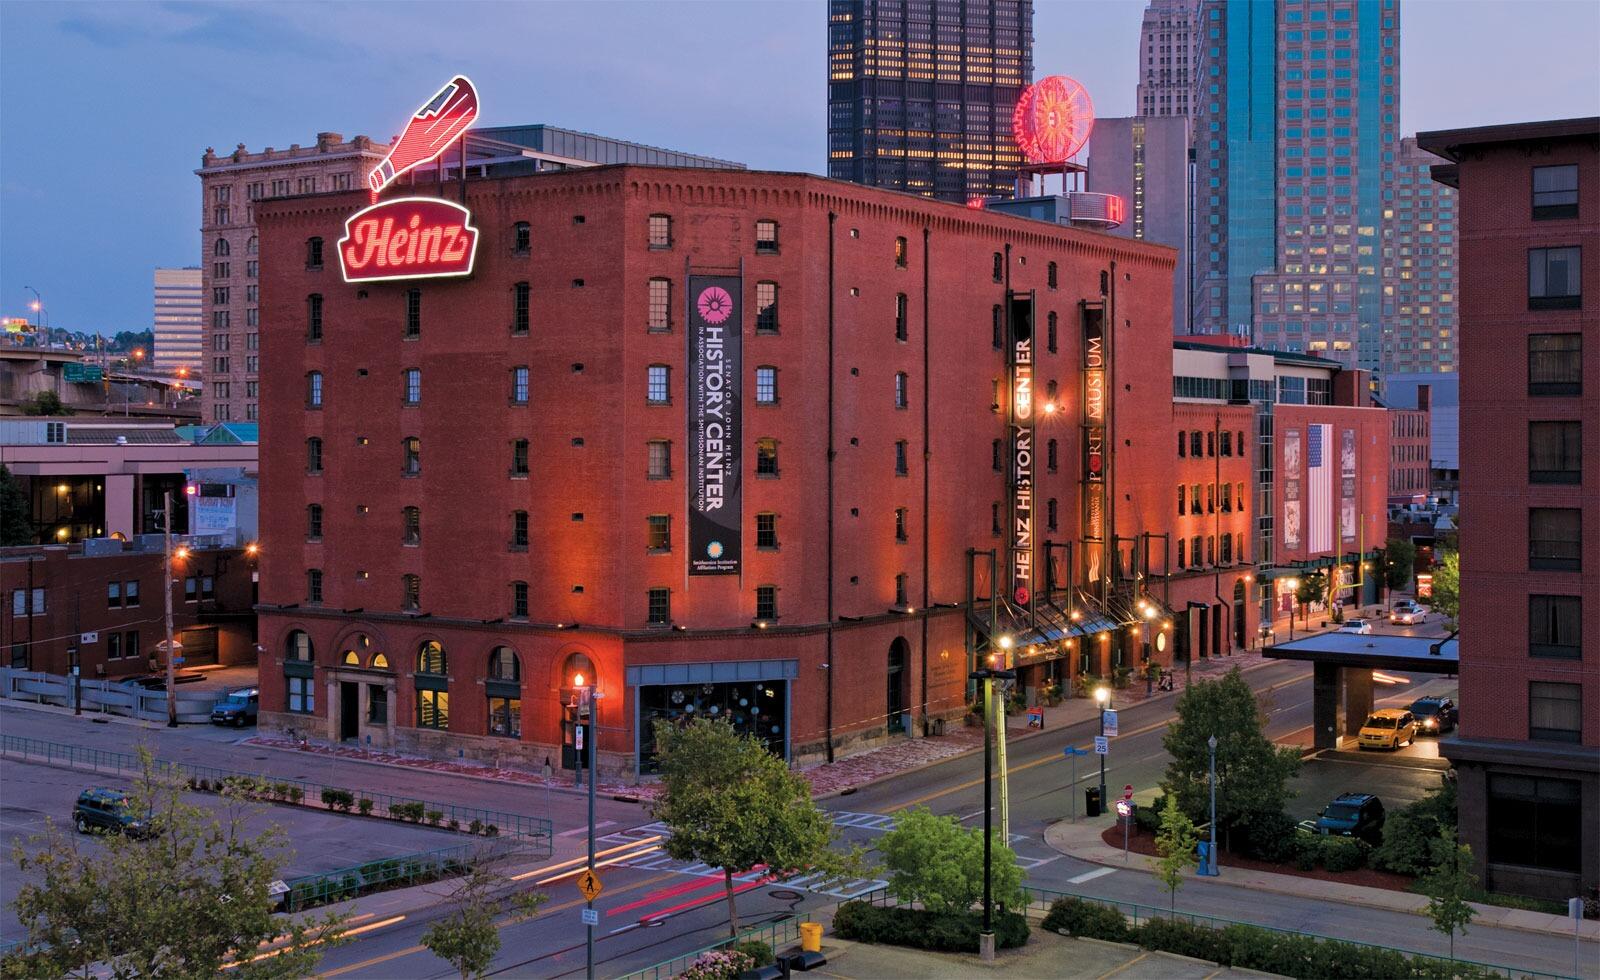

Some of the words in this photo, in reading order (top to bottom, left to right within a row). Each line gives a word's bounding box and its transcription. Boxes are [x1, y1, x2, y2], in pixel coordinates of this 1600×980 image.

[346, 215, 468, 268] Heinz
[706, 327, 723, 419] HISTORY
[1016, 338, 1031, 419] CENTER
[706, 422, 723, 512] CENTER
[1016, 425, 1031, 509] HISTORY
[1016, 517, 1030, 579] HENZ
